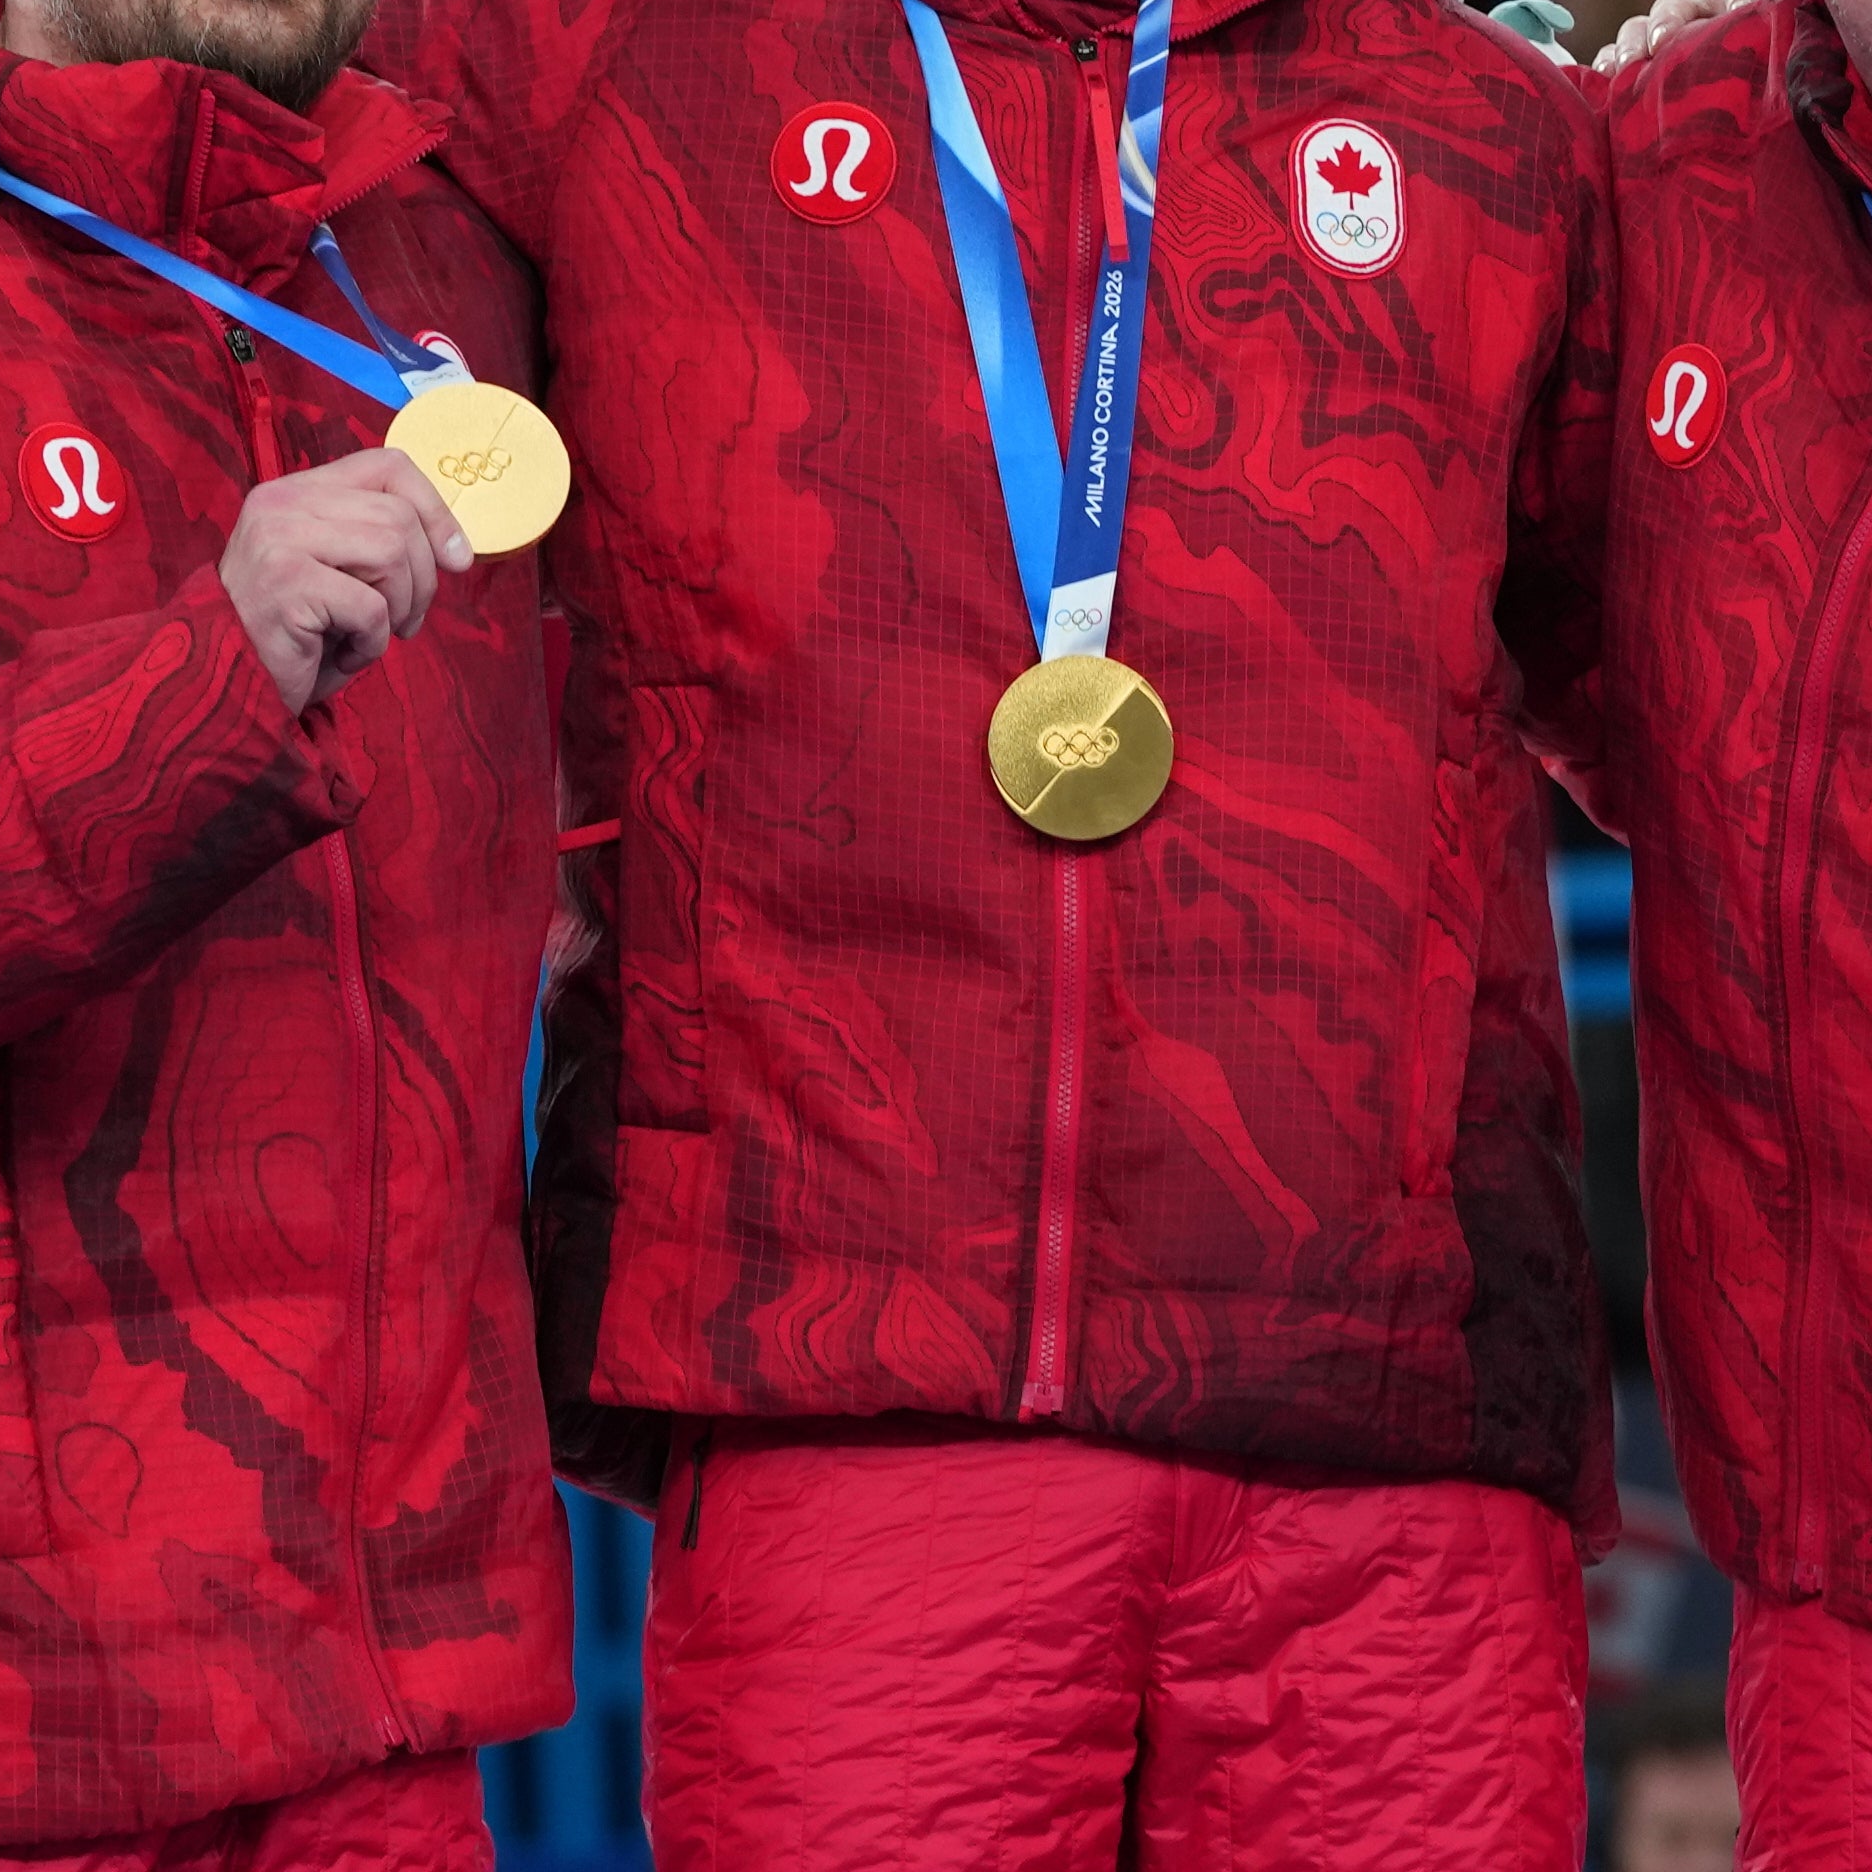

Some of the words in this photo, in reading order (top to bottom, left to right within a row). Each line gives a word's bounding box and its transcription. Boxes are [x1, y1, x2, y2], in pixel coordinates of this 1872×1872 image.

[1104, 269, 1124, 318] 2026
[1093, 322, 1119, 424] CORTINA
[1083, 427, 1110, 528] MILANO
